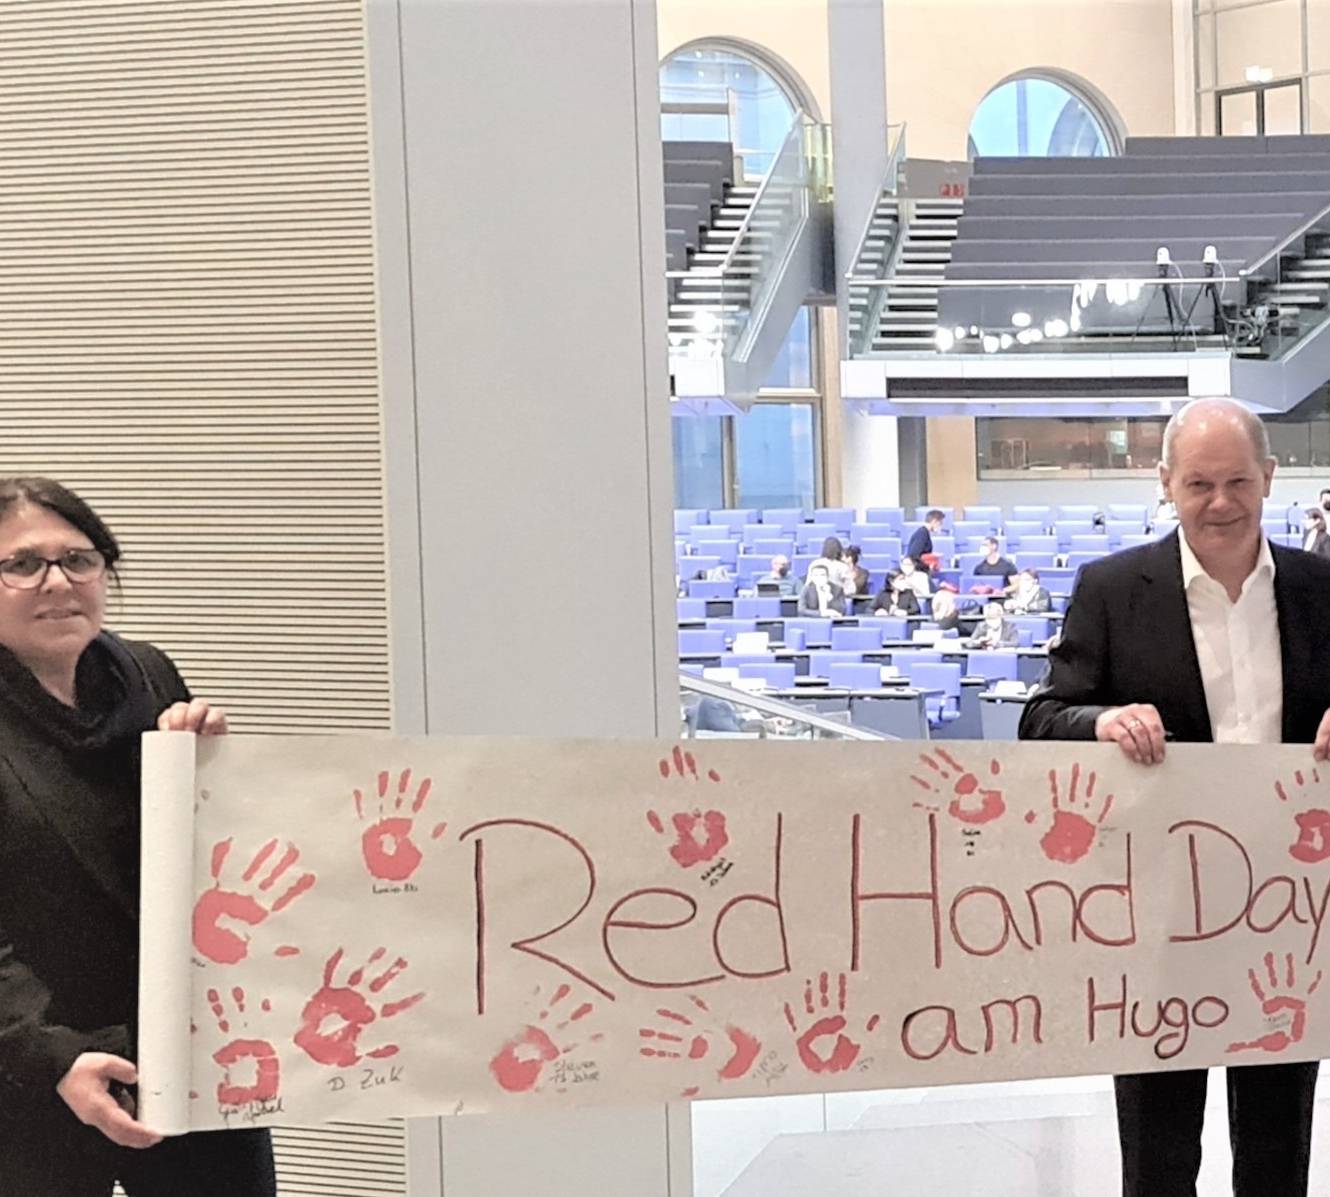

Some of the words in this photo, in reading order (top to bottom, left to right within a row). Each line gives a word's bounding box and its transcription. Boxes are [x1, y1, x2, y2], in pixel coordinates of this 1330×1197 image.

[459, 811, 791, 1016] Red
[850, 813, 1137, 972] Hand
[900, 994, 1044, 1061] am
[1087, 973, 1230, 1060] Hugo
